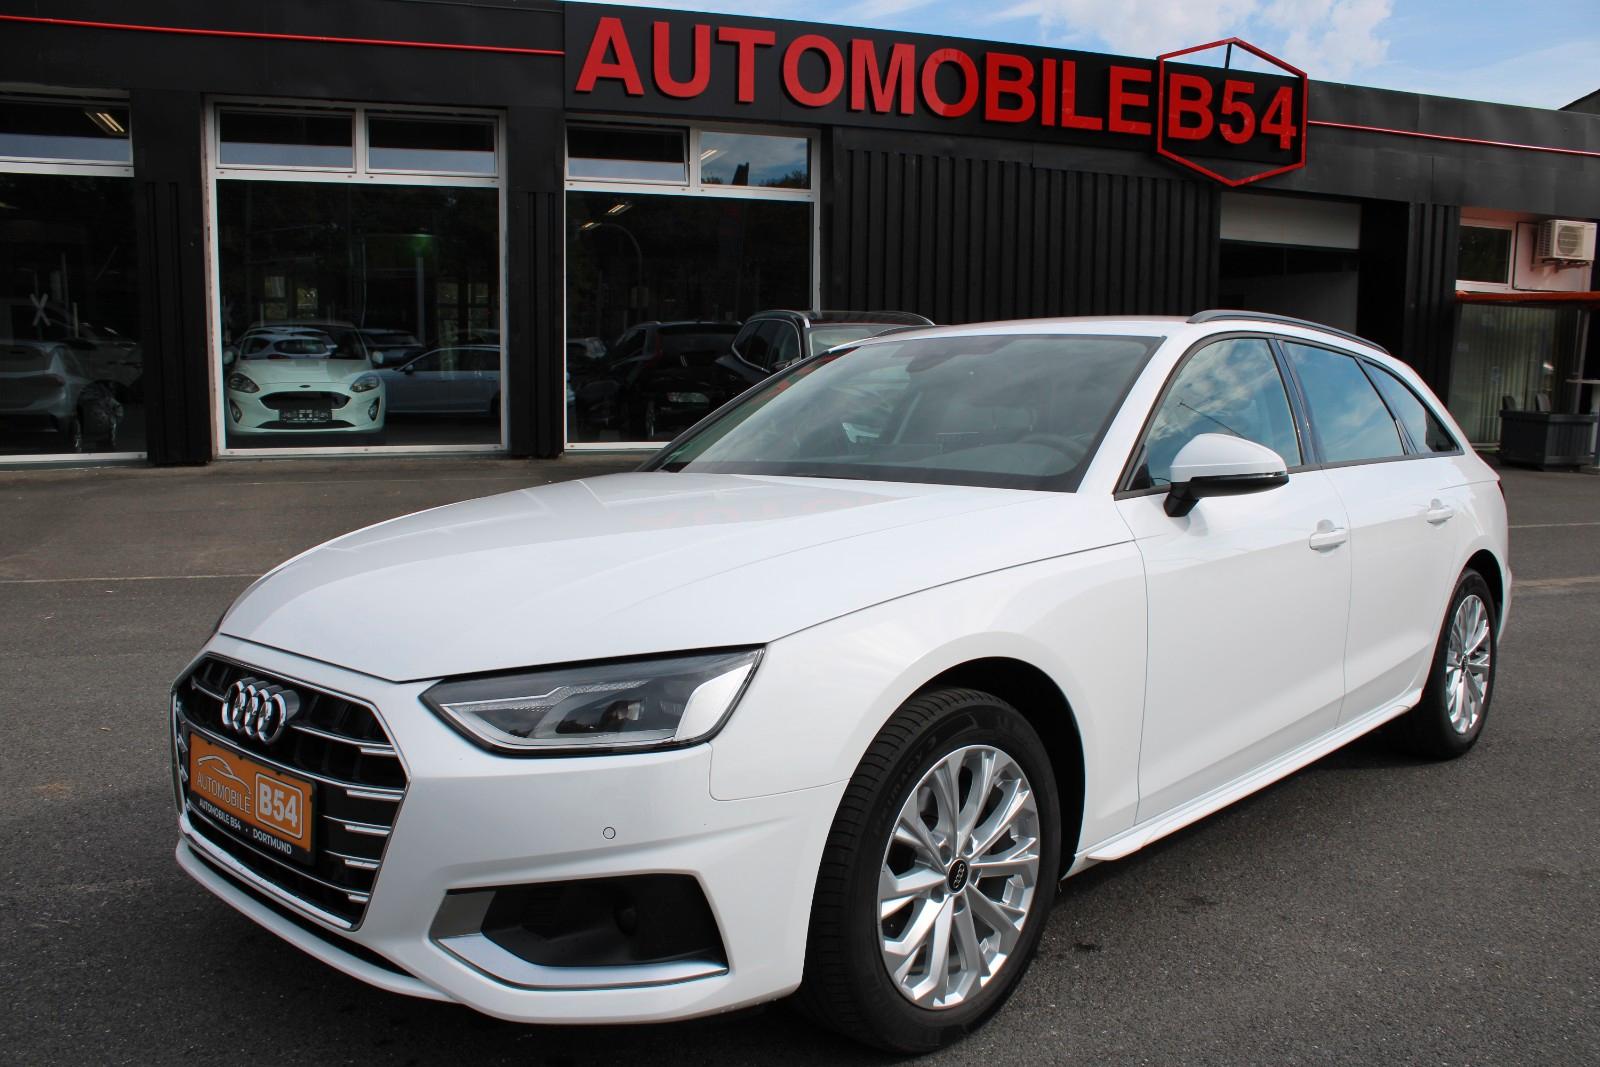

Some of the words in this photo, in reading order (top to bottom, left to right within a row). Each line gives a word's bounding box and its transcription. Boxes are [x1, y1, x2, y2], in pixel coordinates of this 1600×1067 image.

[575, 16, 1152, 136] AUTOMOBILE
[1167, 72, 1297, 150] B54
[196, 772, 251, 815] AUTOMOBILE
[259, 783, 298, 828] B54
[199, 799, 230, 825] AUTOMOBILE
[230, 816, 241, 831] B54
[253, 828, 292, 855] DORTMUND
